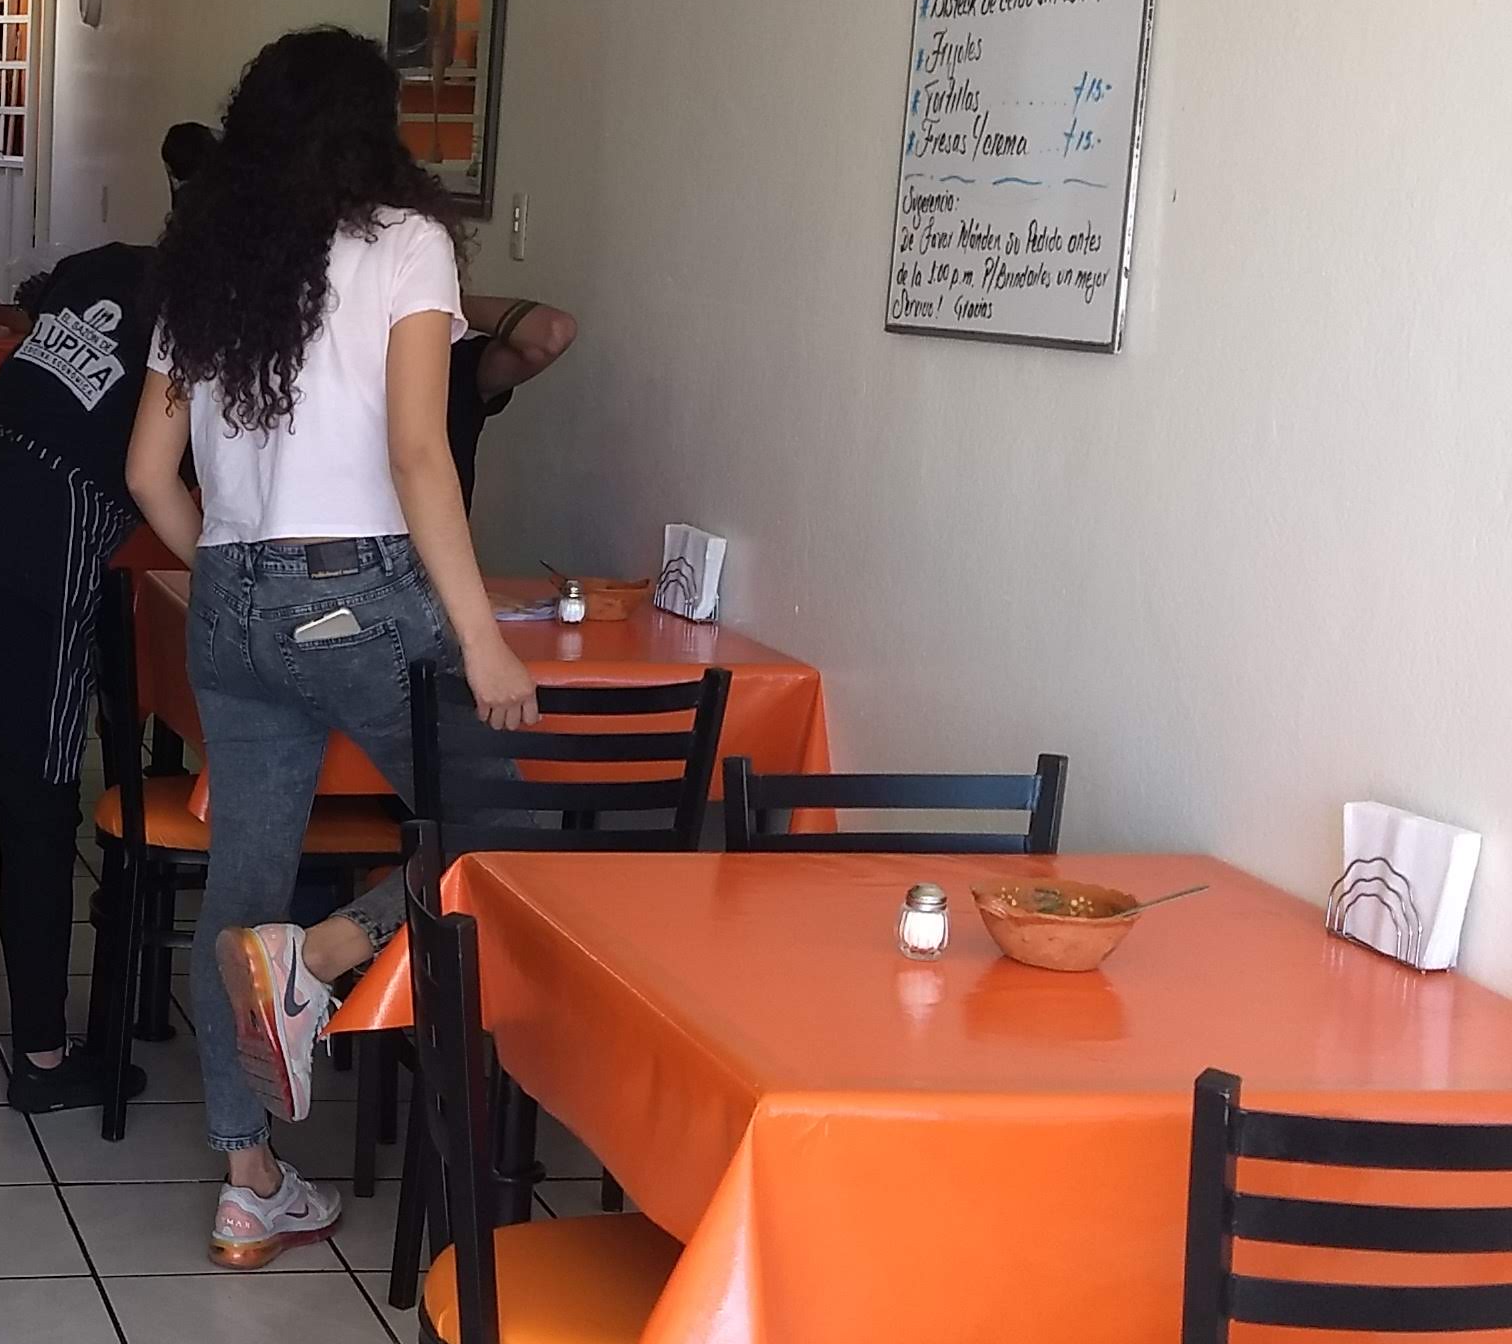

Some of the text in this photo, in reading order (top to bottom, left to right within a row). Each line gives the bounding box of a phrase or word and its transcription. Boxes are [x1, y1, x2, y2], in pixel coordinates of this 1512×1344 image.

[924, 79, 980, 117] Tortillas
[916, 118, 967, 157] Fresas
[1026, 219, 1062, 253] Pedido
[1068, 220, 1101, 255] antes
[897, 262, 907, 285] de
[911, 262, 921, 287] la
[1056, 269, 1072, 285] un
[1075, 267, 1110, 304] mejor
[954, 295, 992, 321] Gracias
[31, 322, 113, 391] LUPITA
